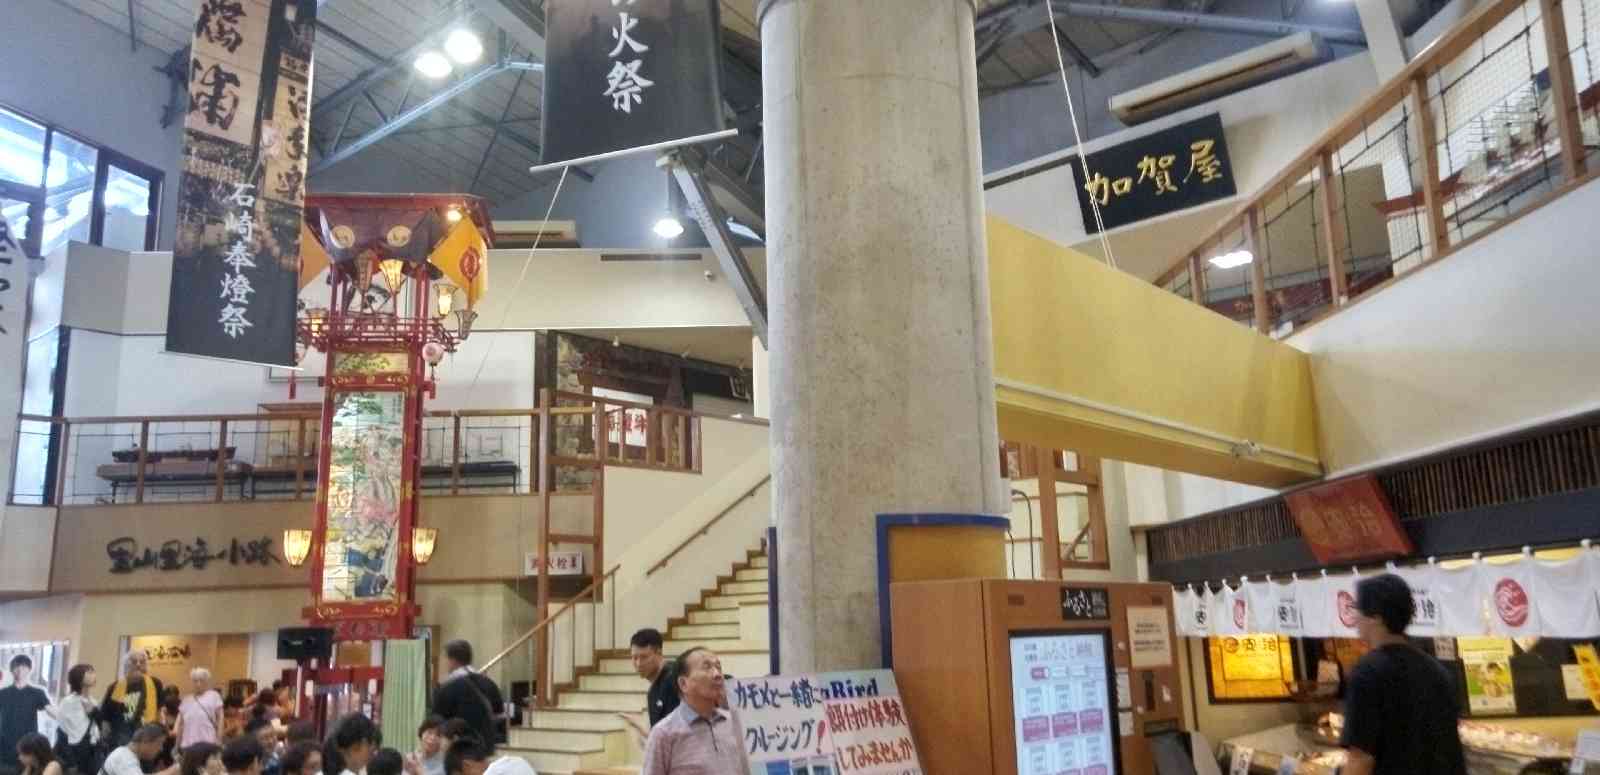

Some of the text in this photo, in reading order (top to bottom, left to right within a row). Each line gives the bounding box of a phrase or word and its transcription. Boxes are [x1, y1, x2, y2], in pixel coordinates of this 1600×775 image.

[603, 0, 655, 113] 火祭
[1085, 139, 1222, 206] 加賀屋
[218, 183, 257, 339] 石崎奉燈祭
[734, 677, 822, 710] カモメと一緒に
[826, 699, 907, 733] 餌付け体験
[838, 738, 913, 771] してみませんか
